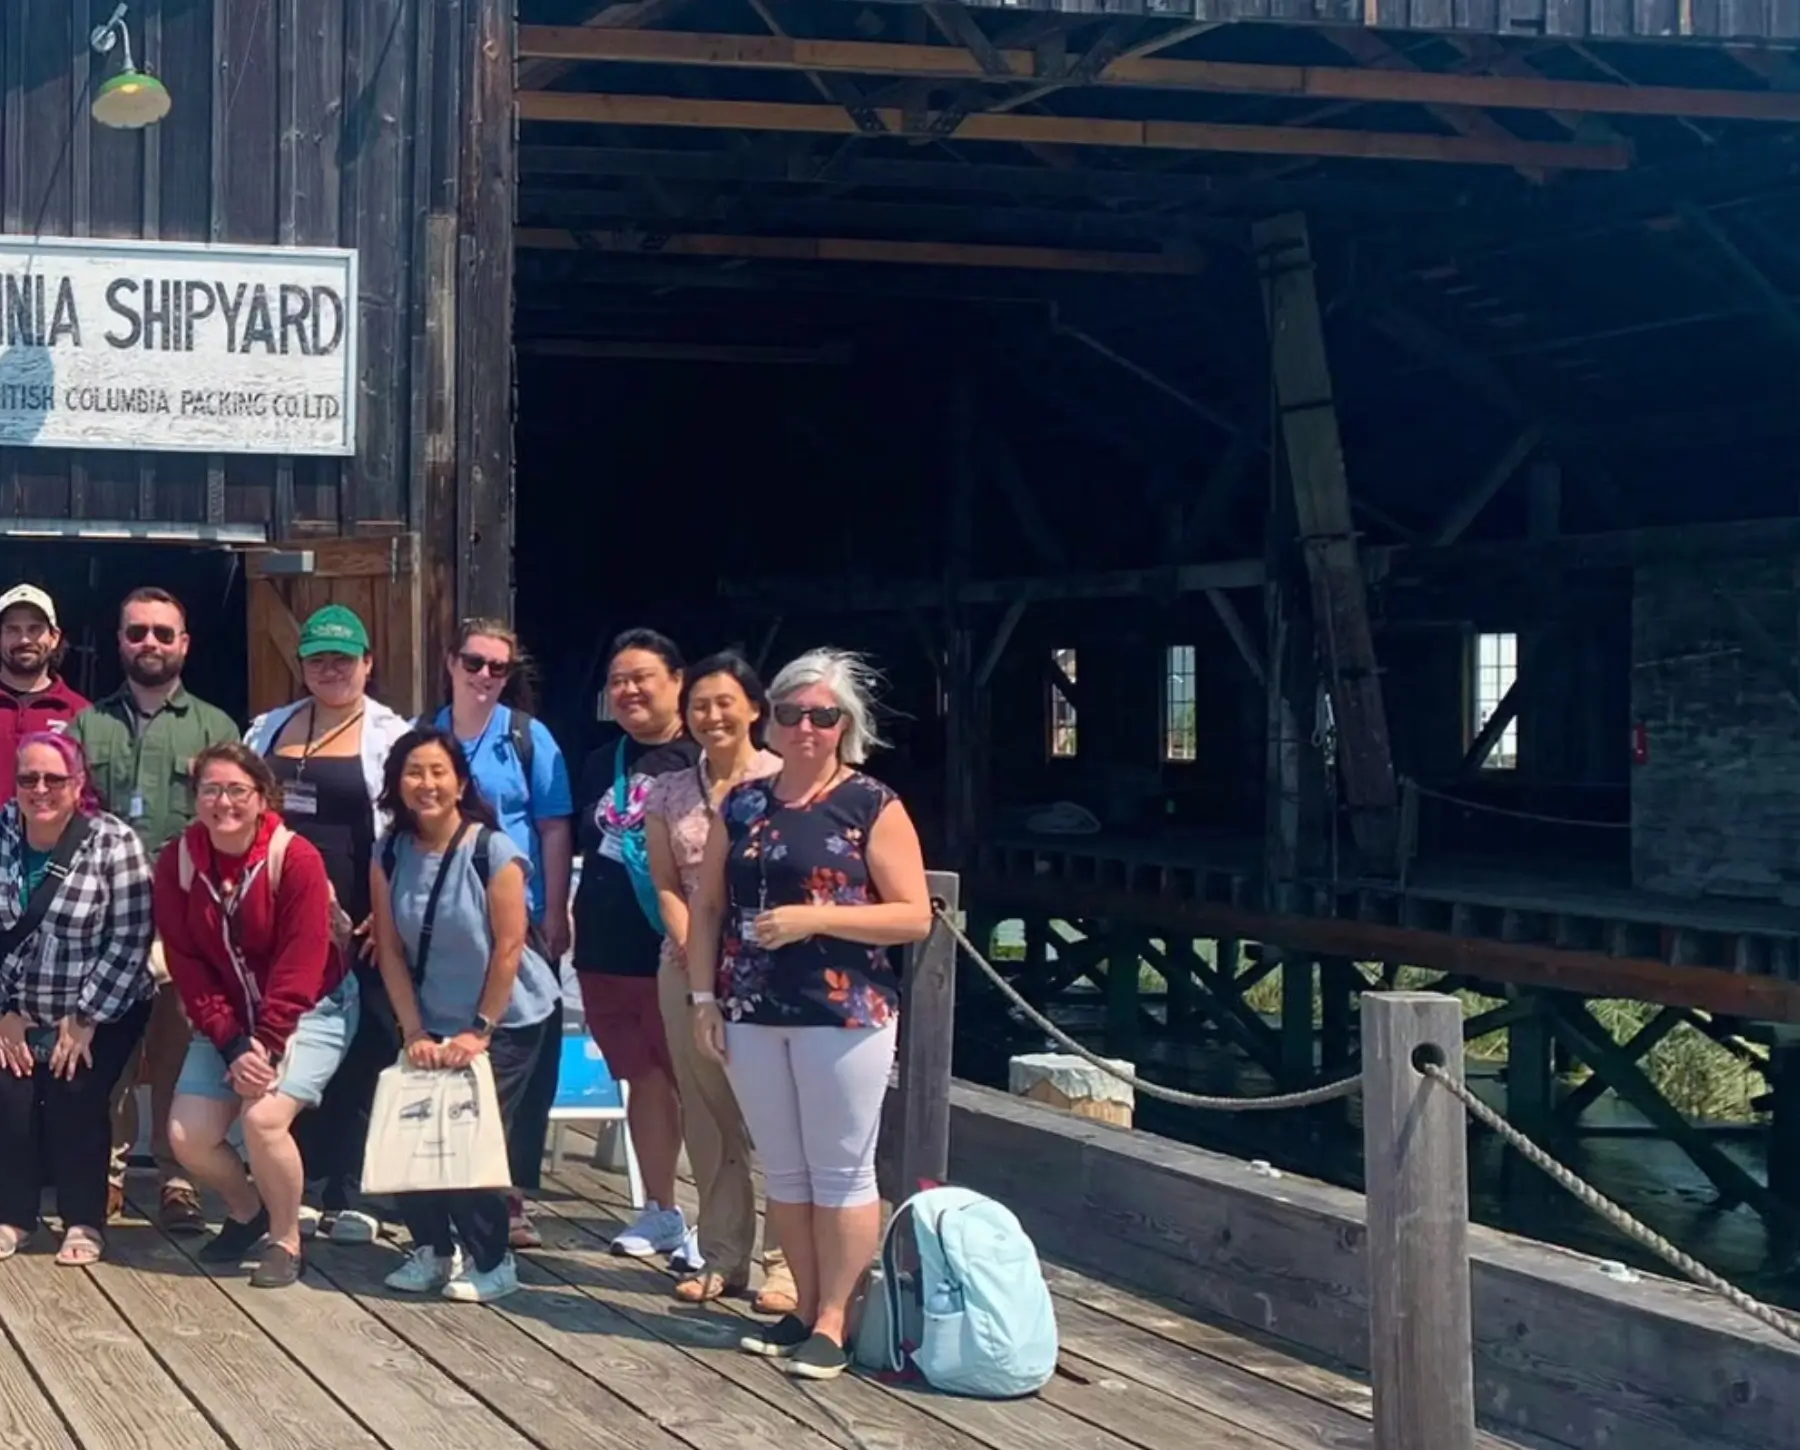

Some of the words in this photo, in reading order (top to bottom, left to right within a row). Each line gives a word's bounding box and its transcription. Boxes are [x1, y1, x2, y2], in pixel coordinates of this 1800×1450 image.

[103, 277, 344, 356] SHIPYARD
[65, 387, 171, 414] COLUMBIA
[180, 390, 268, 417] PACKING
